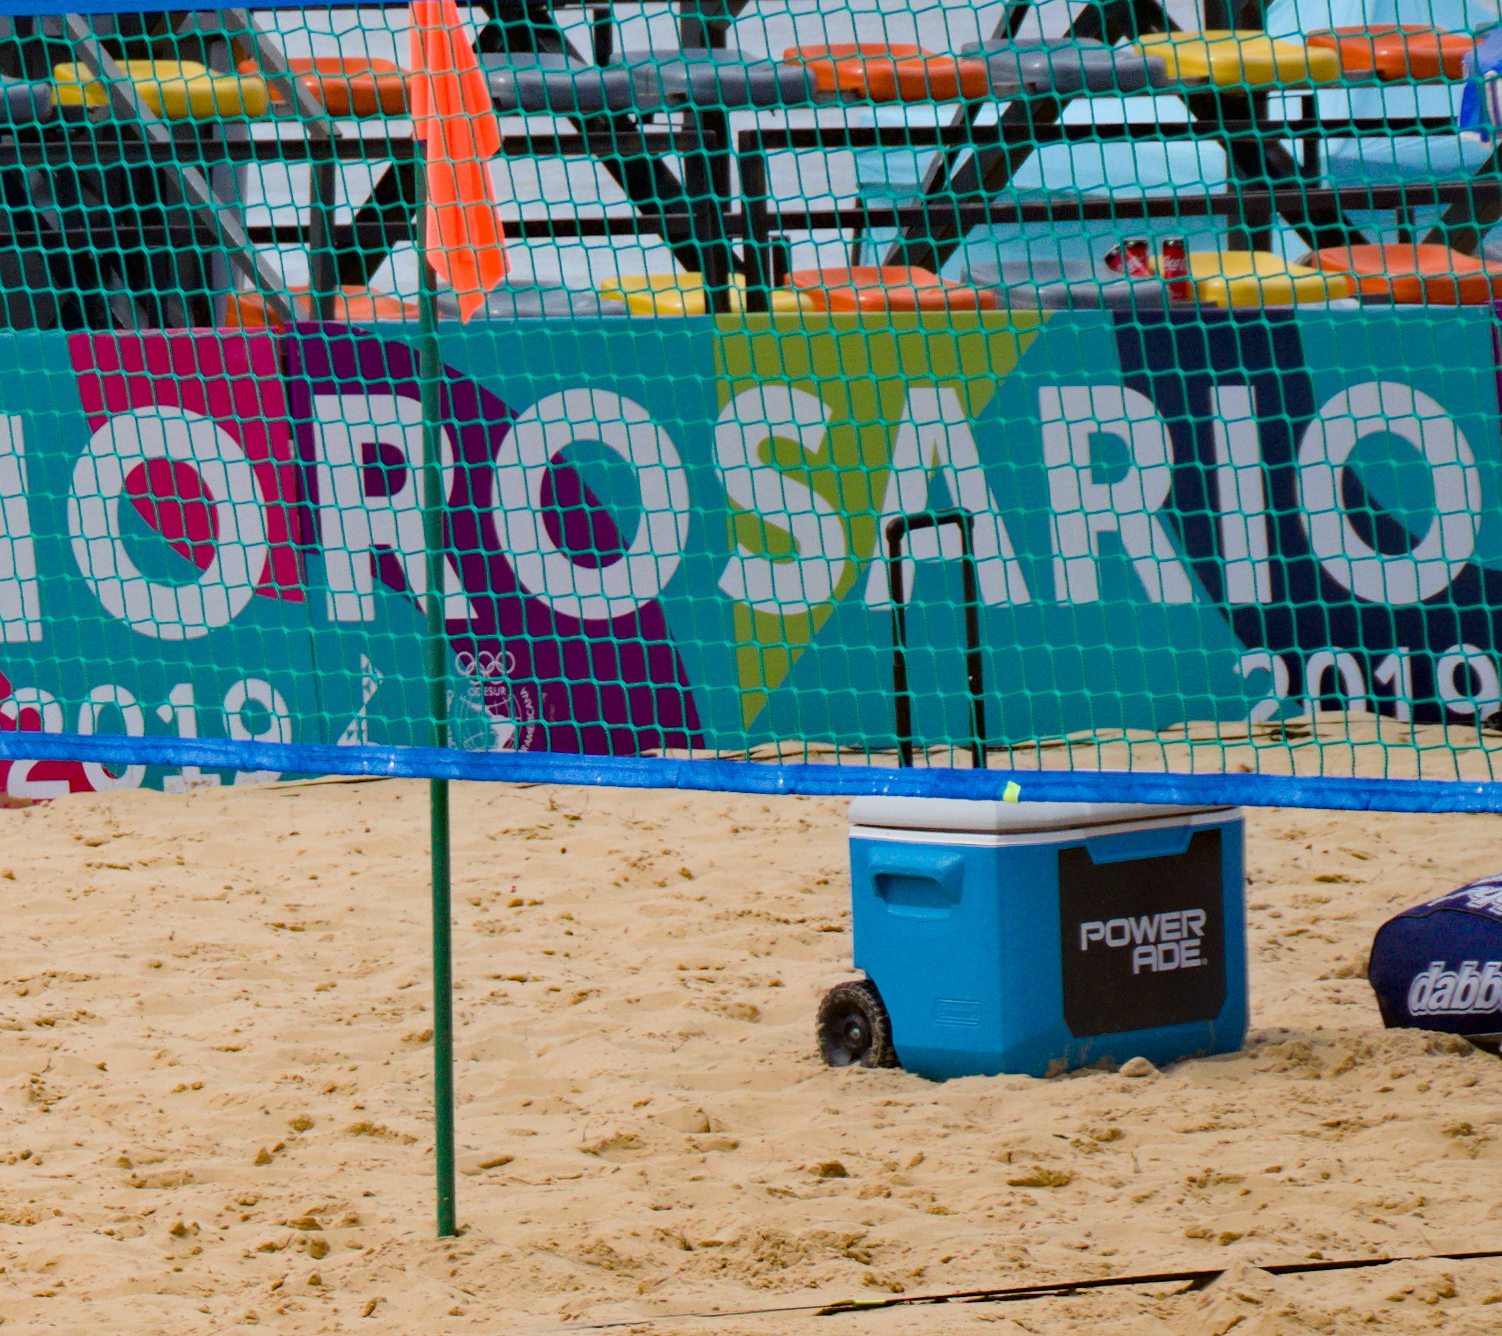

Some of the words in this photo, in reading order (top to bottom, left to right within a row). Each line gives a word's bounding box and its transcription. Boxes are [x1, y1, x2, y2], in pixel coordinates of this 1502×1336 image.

[310, 381, 1482, 623] ROSARIO
[1232, 643, 1502, 725] 2019
[0, 677, 293, 800] 2019
[1079, 907, 1207, 952] POWER
[1132, 938, 1204, 975] ADE
[1408, 960, 1502, 1016] dabb
